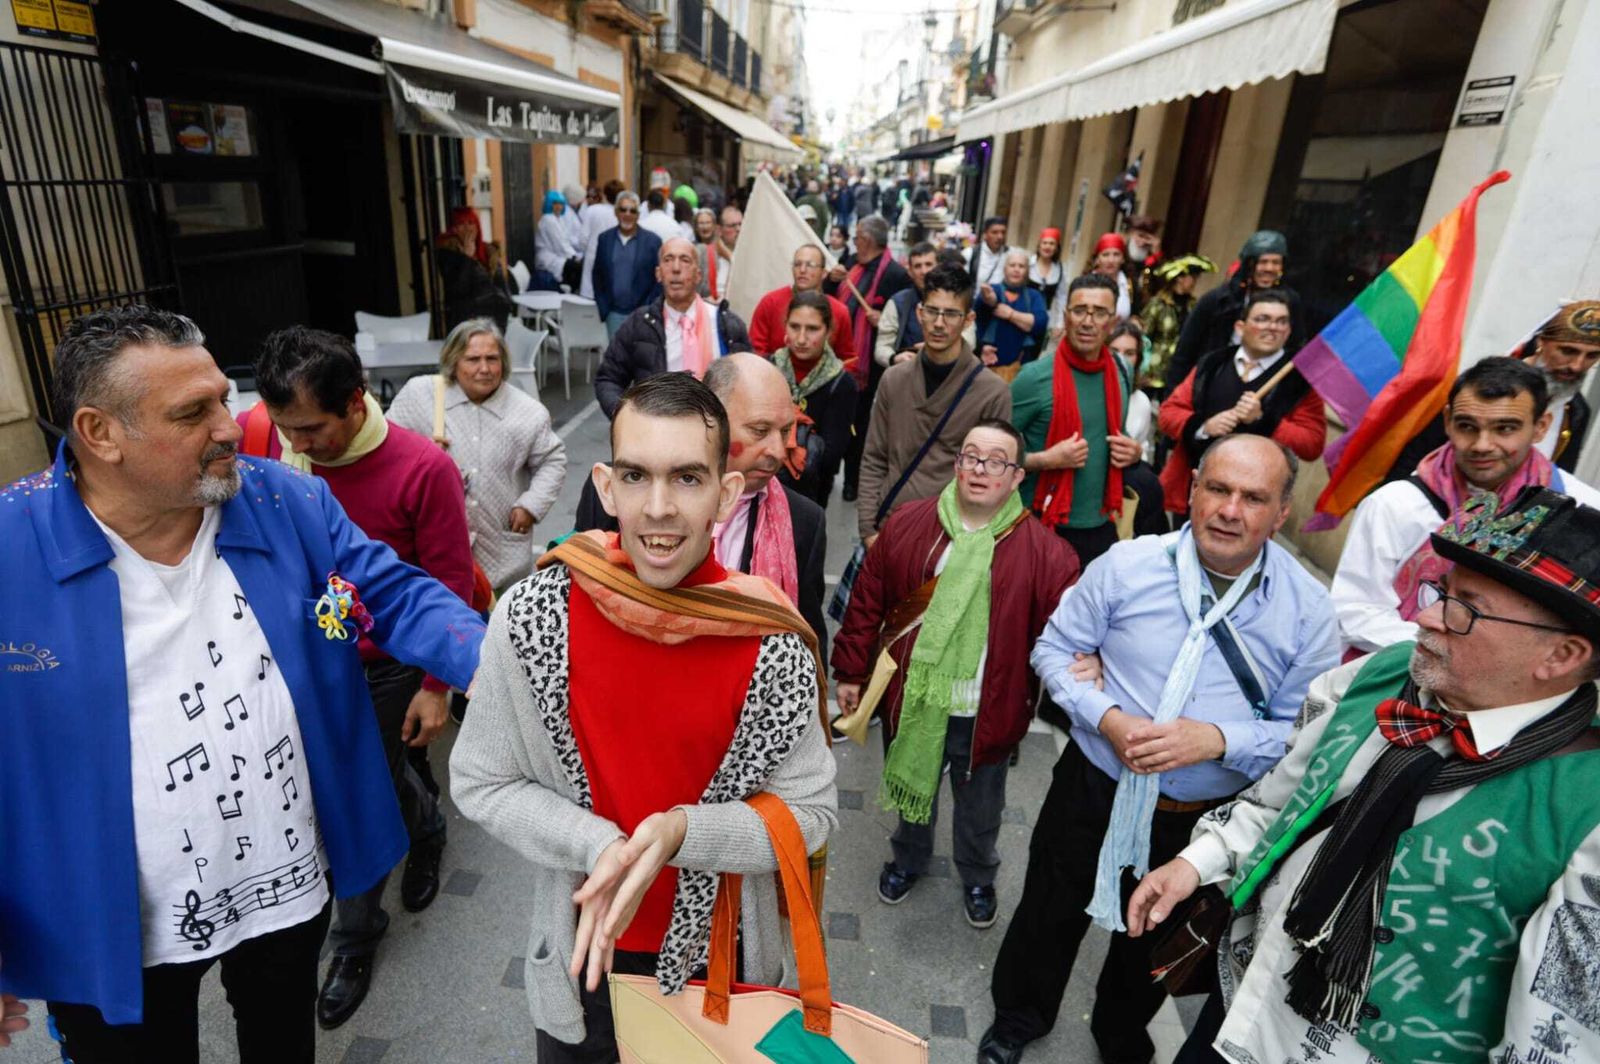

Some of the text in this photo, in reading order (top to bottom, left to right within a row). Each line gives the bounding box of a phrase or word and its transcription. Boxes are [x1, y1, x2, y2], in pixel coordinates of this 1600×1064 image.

[487, 96, 513, 128] Las
[520, 101, 563, 139] Tapitas
[566, 109, 580, 136] de
